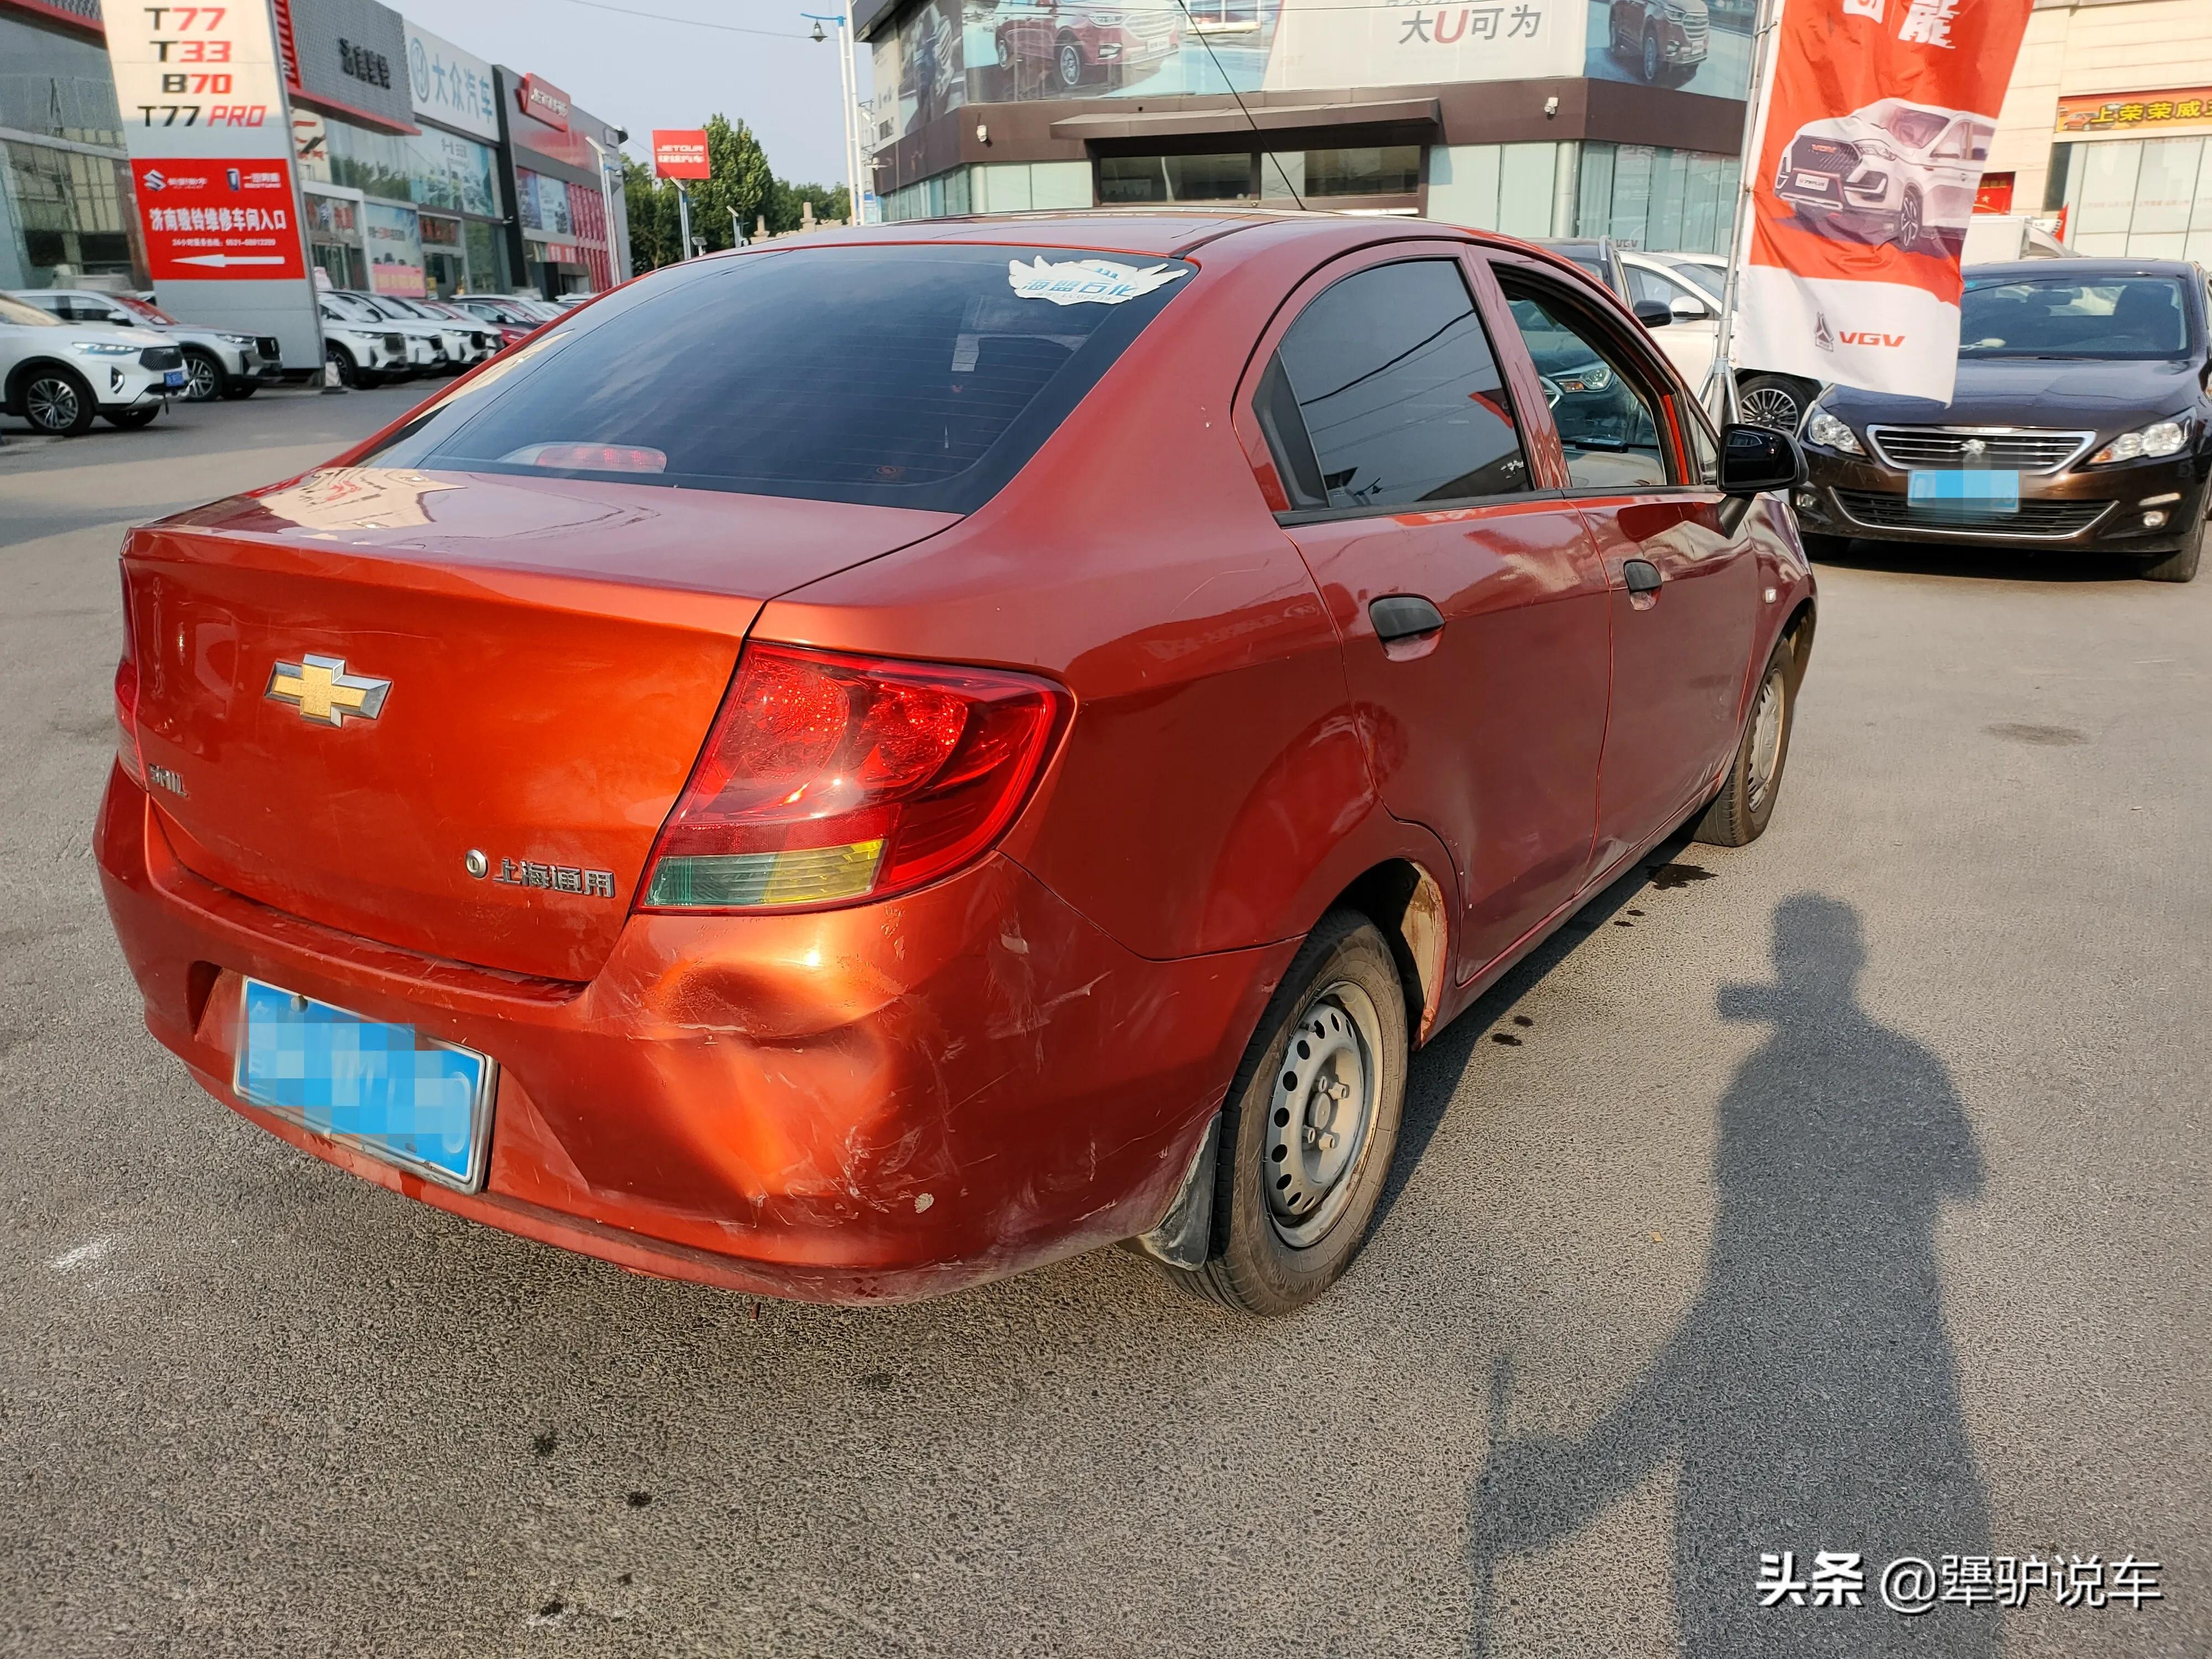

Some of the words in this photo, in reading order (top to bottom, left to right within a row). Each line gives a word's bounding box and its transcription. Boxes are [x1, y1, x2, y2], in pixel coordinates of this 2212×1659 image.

[144, 8, 227, 32] T77
[1398, 4, 1542, 44] 大U可为
[149, 41, 232, 62] T33
[162, 74, 232, 93] B70
[432, 54, 493, 124] 大众汽车
[137, 105, 201, 127] T77
[207, 105, 267, 128] PRO
[1839, 331, 1906, 347] VGV
[492, 858, 615, 898] 上海通用
